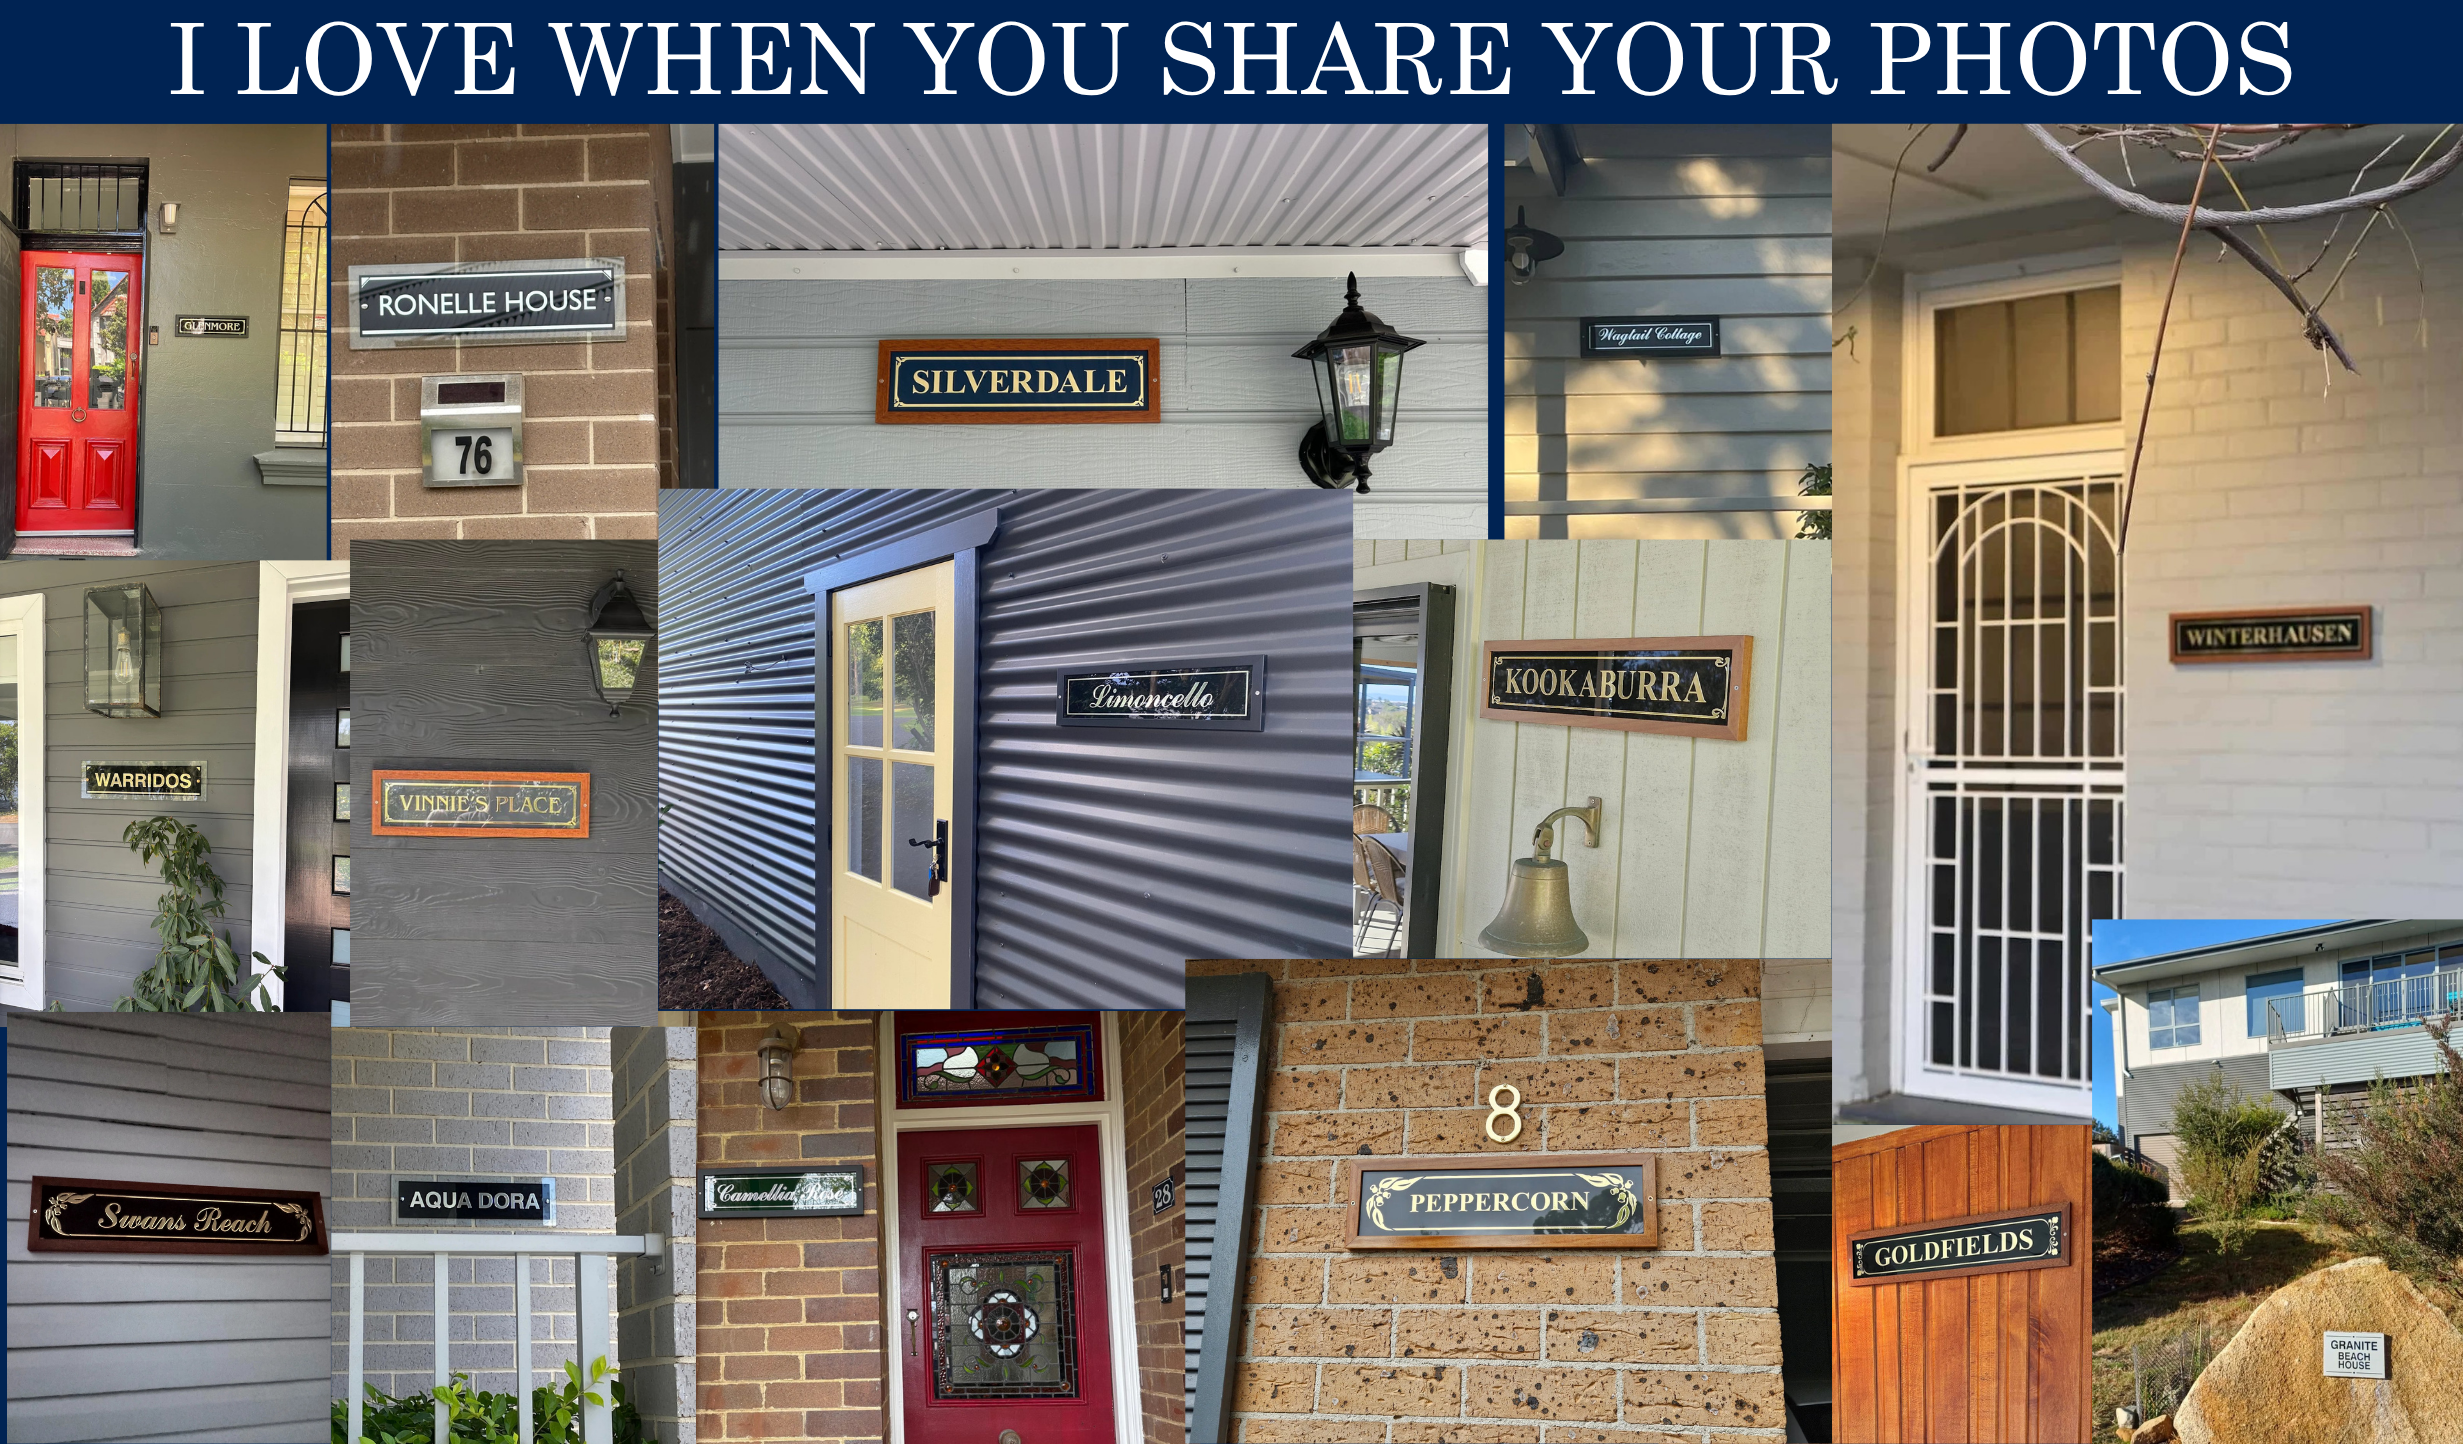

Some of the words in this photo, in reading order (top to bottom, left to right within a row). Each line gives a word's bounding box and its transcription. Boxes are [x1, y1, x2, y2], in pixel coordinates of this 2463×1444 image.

[379, 291, 496, 316] RONELLE
[505, 289, 597, 313] HOUSE
[184, 321, 241, 331] GLENMORE
[1598, 327, 1650, 343] Wagtail
[1656, 327, 1702, 343] Cottage
[912, 368, 1128, 394] SILVERDALE
[455, 435, 493, 474] 76
[2186, 623, 2353, 647] WINTERHAUSEN
[1089, 681, 1214, 709] Limoncello
[1505, 668, 1707, 704] KOOKABURRA
[96, 772, 192, 789] WARRIDOS
[400, 794, 488, 812] VINNIE'S
[496, 797, 562, 814] PLACE
[1485, 1084, 1522, 1143] 8
[410, 1191, 472, 1210] AQUA
[479, 1192, 540, 1210] DORA
[717, 1183, 796, 1203] Camellia
[801, 1183, 846, 1202] Rose
[1154, 1184, 1173, 1210] 28
[1410, 1191, 1590, 1213] PEPPERCORN
[98, 1202, 186, 1230] Swans
[195, 1206, 272, 1233] Reach
[1875, 1228, 2034, 1267] GOLDFIELDS
[2330, 1339, 2378, 1351] GRANITE
[2338, 1352, 2371, 1361] BEACH
[2338, 1361, 2371, 1370] HOUSE
